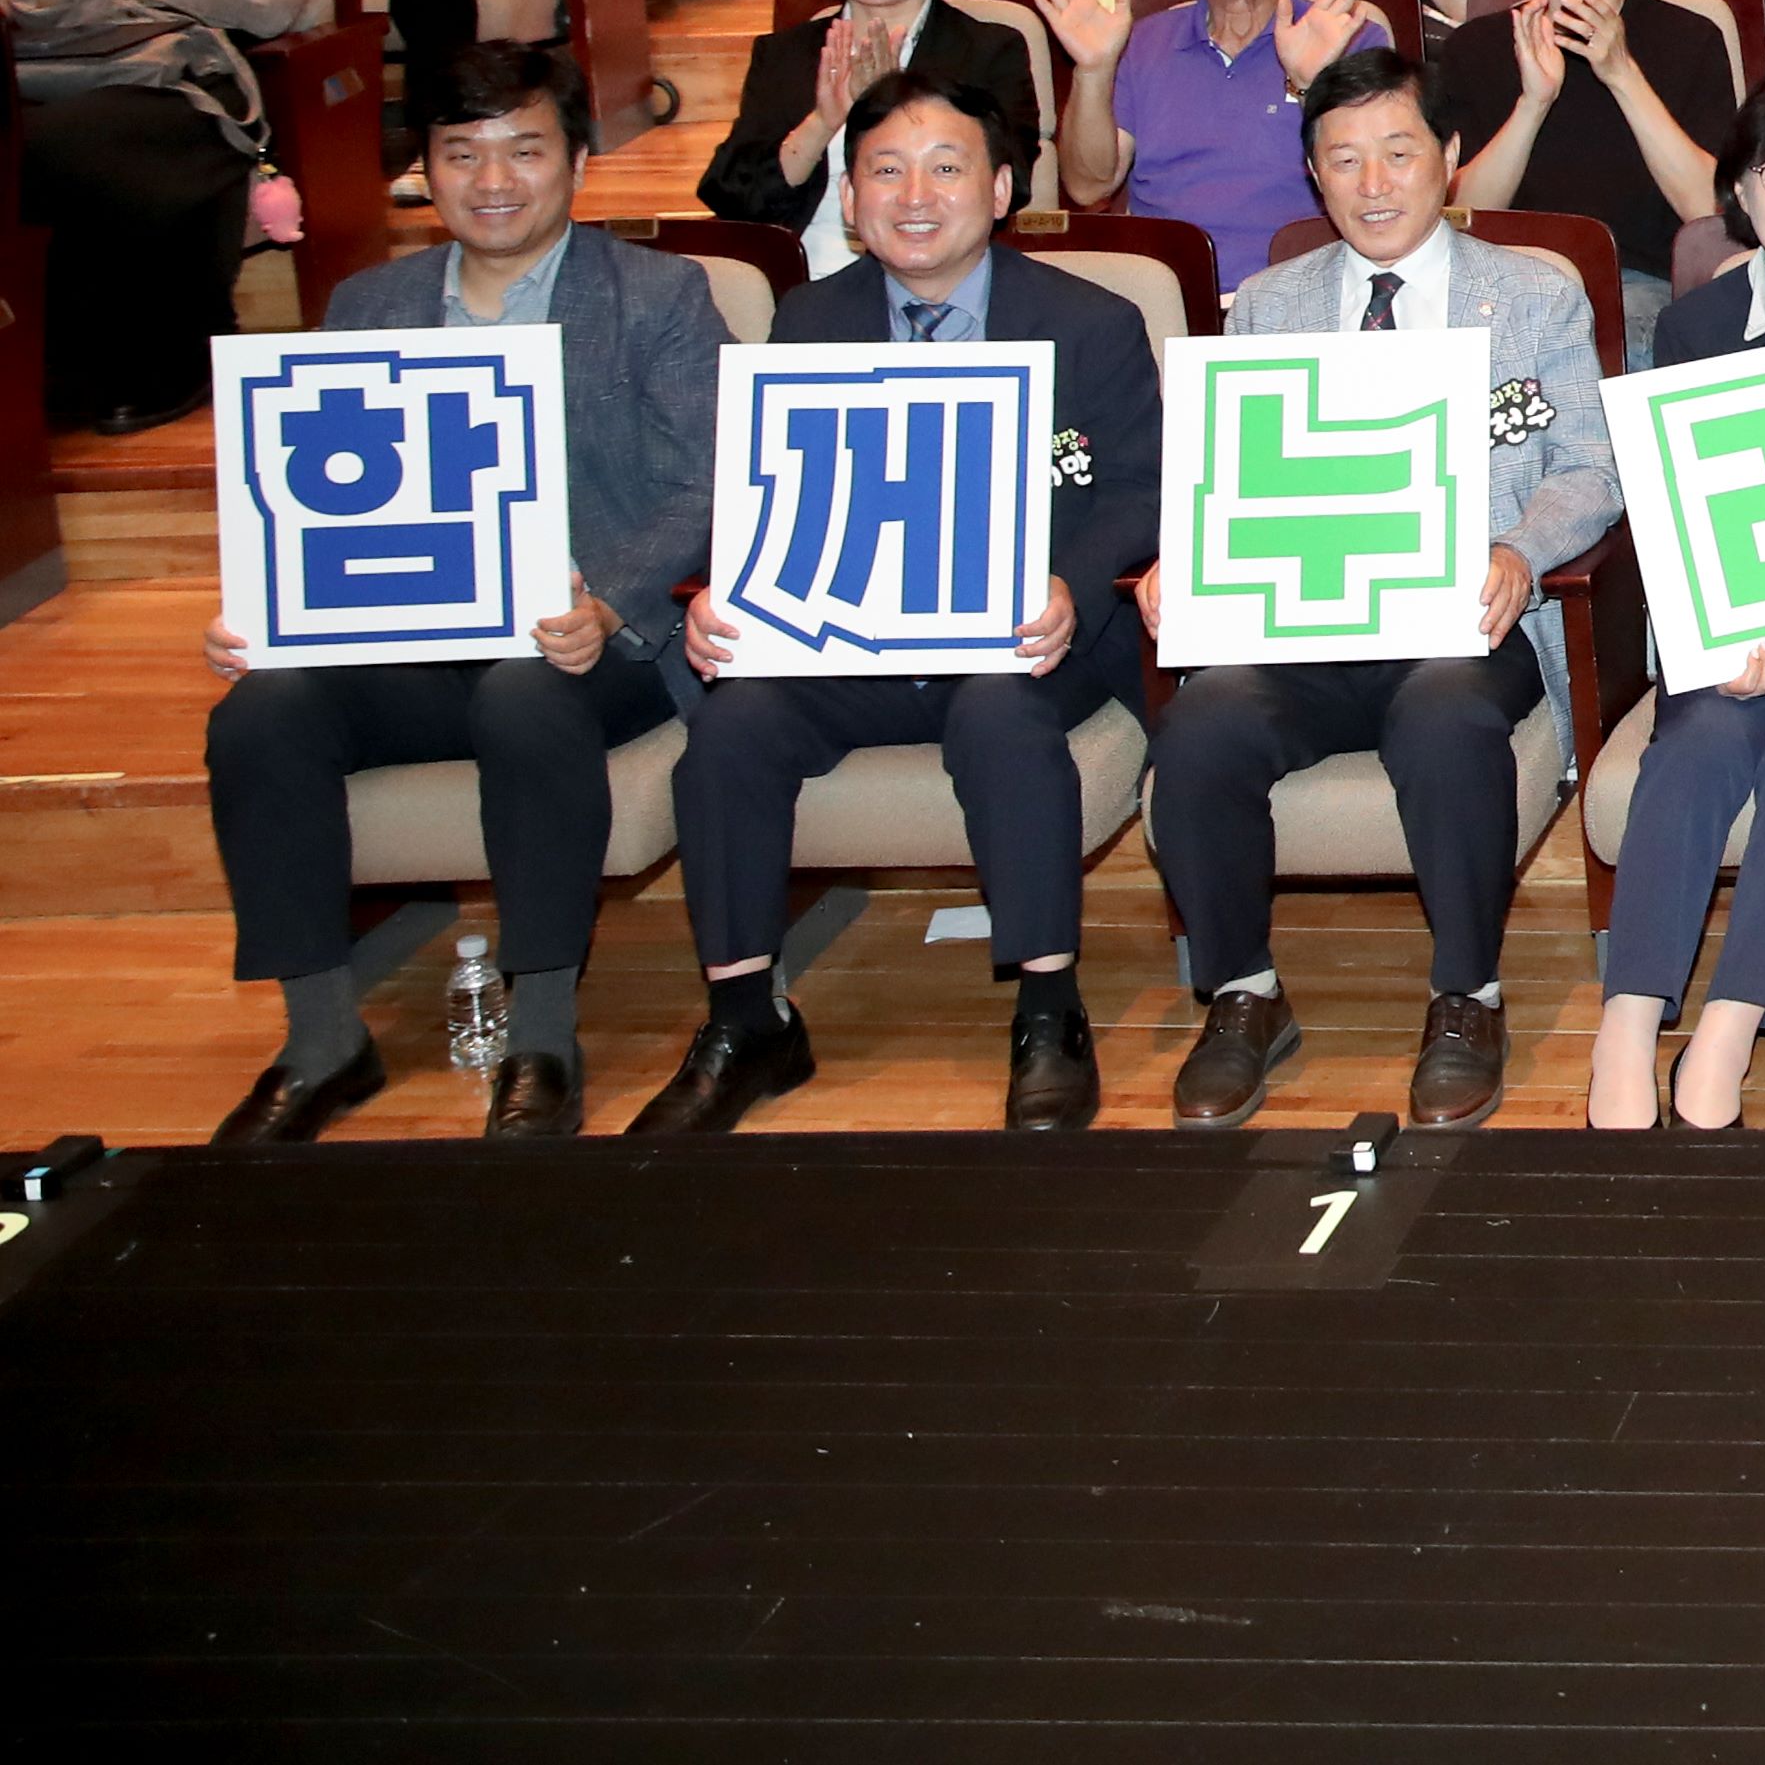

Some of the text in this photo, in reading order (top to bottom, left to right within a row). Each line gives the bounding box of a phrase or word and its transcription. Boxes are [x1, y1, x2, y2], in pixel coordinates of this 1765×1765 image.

[241, 351, 537, 647] 함
[728, 365, 1030, 655] 께
[1192, 358, 1457, 638] 누
[1299, 1190, 1358, 1255] 1
